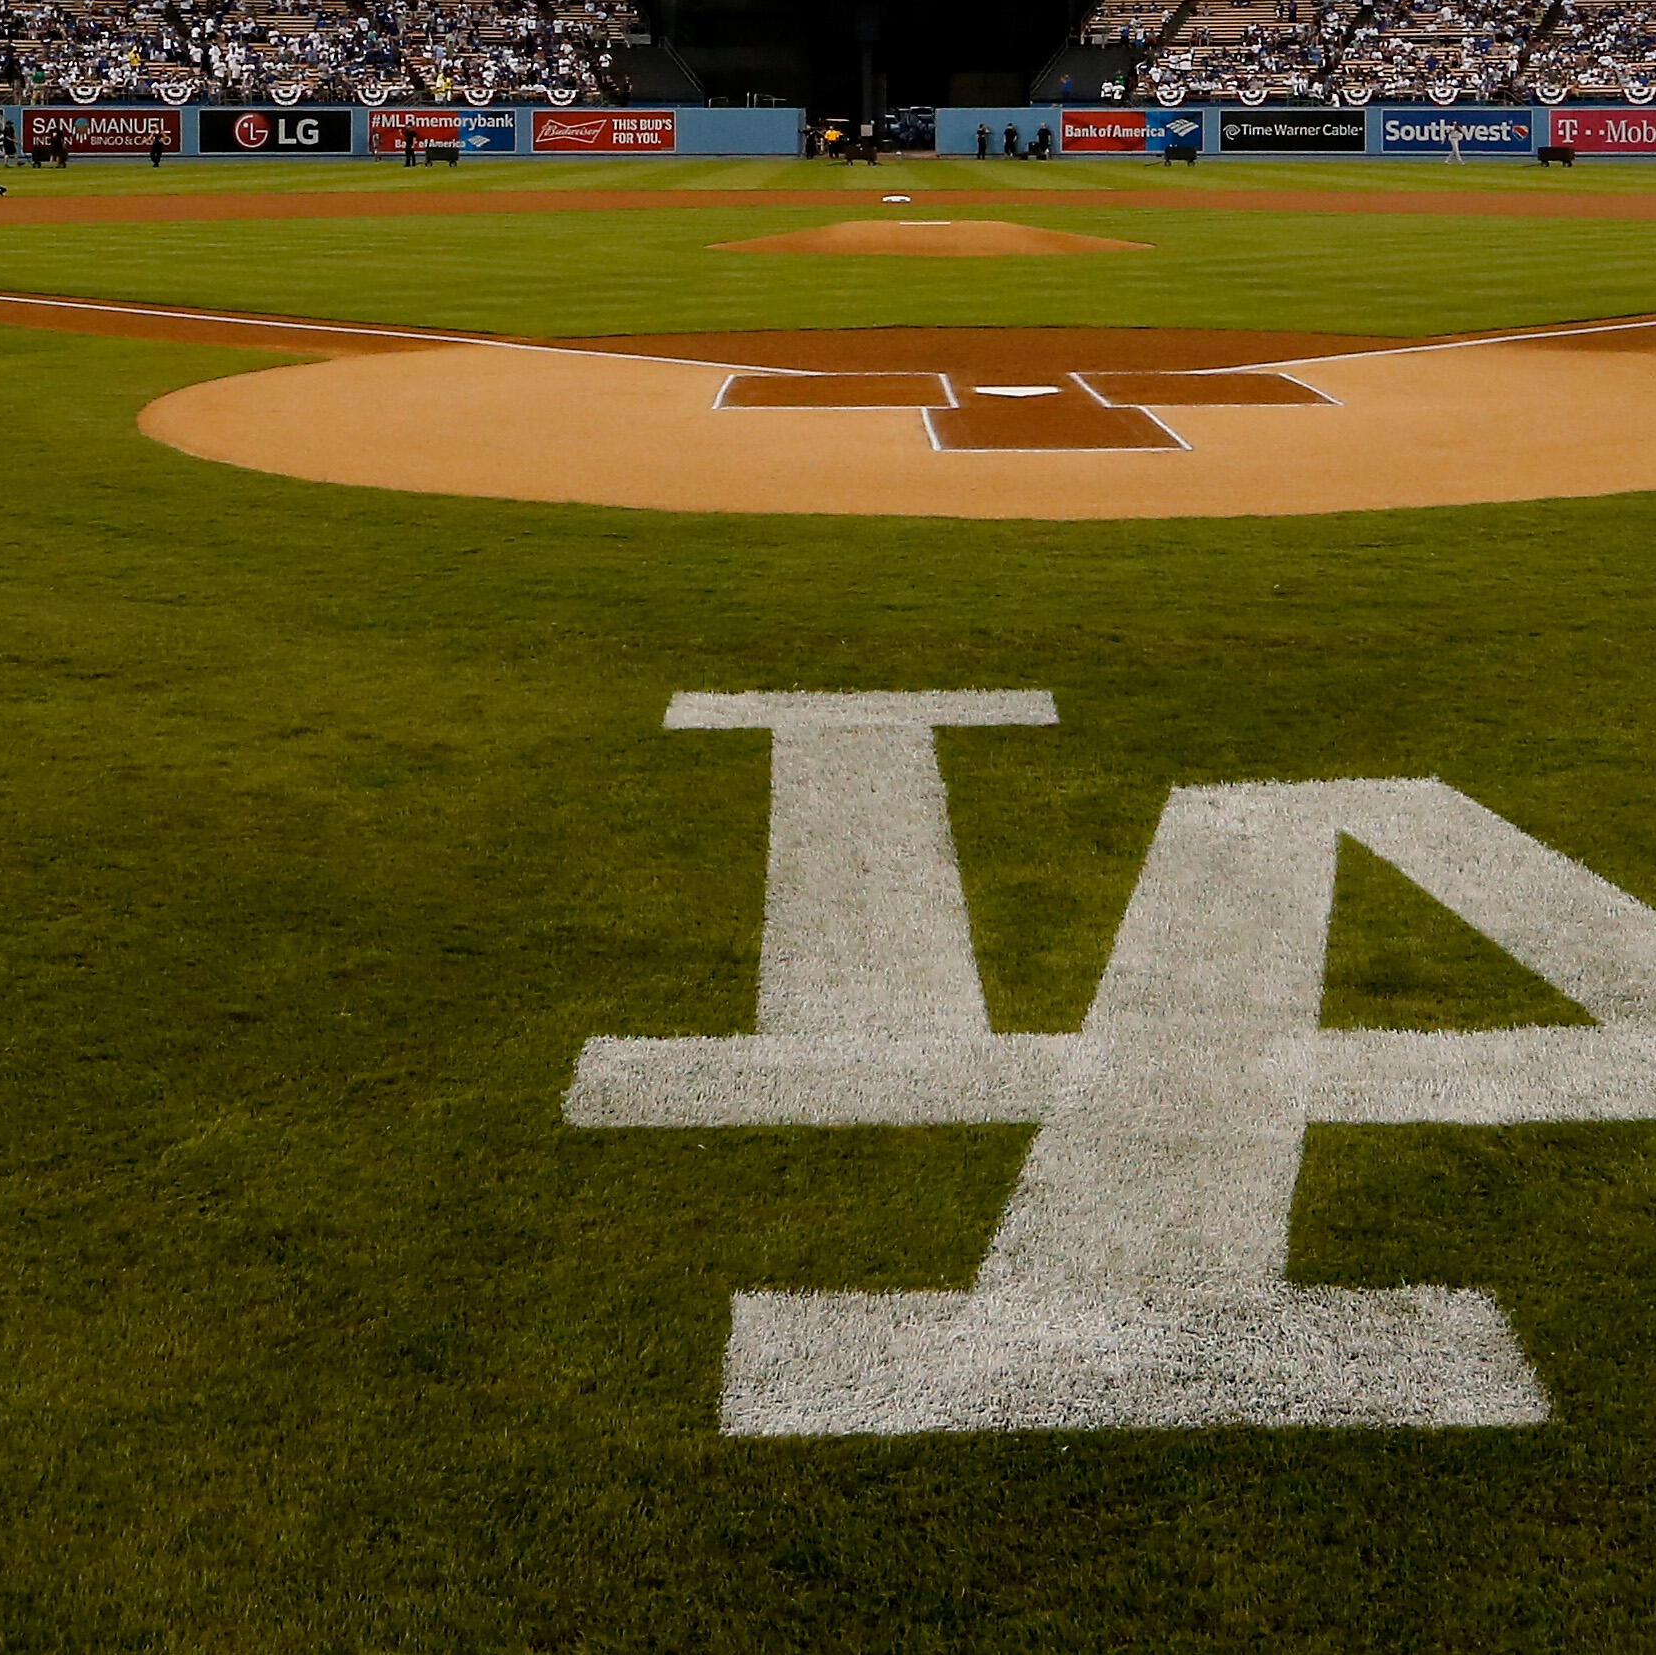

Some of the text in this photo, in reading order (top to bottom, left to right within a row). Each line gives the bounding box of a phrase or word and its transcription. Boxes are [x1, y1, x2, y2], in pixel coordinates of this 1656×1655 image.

[32, 117, 172, 134] SAN MANUEL
[543, 124, 601, 137] Budweiser
[612, 118, 672, 131] THIS BUD'S
[1065, 124, 1166, 138] Bank of America
[1240, 123, 1360, 137] Time Warner Cable
[277, 118, 320, 145] LG
[612, 132, 662, 144] FOR YOU.
[32, 136, 73, 146] INDN
[395, 139, 418, 149] Bak
